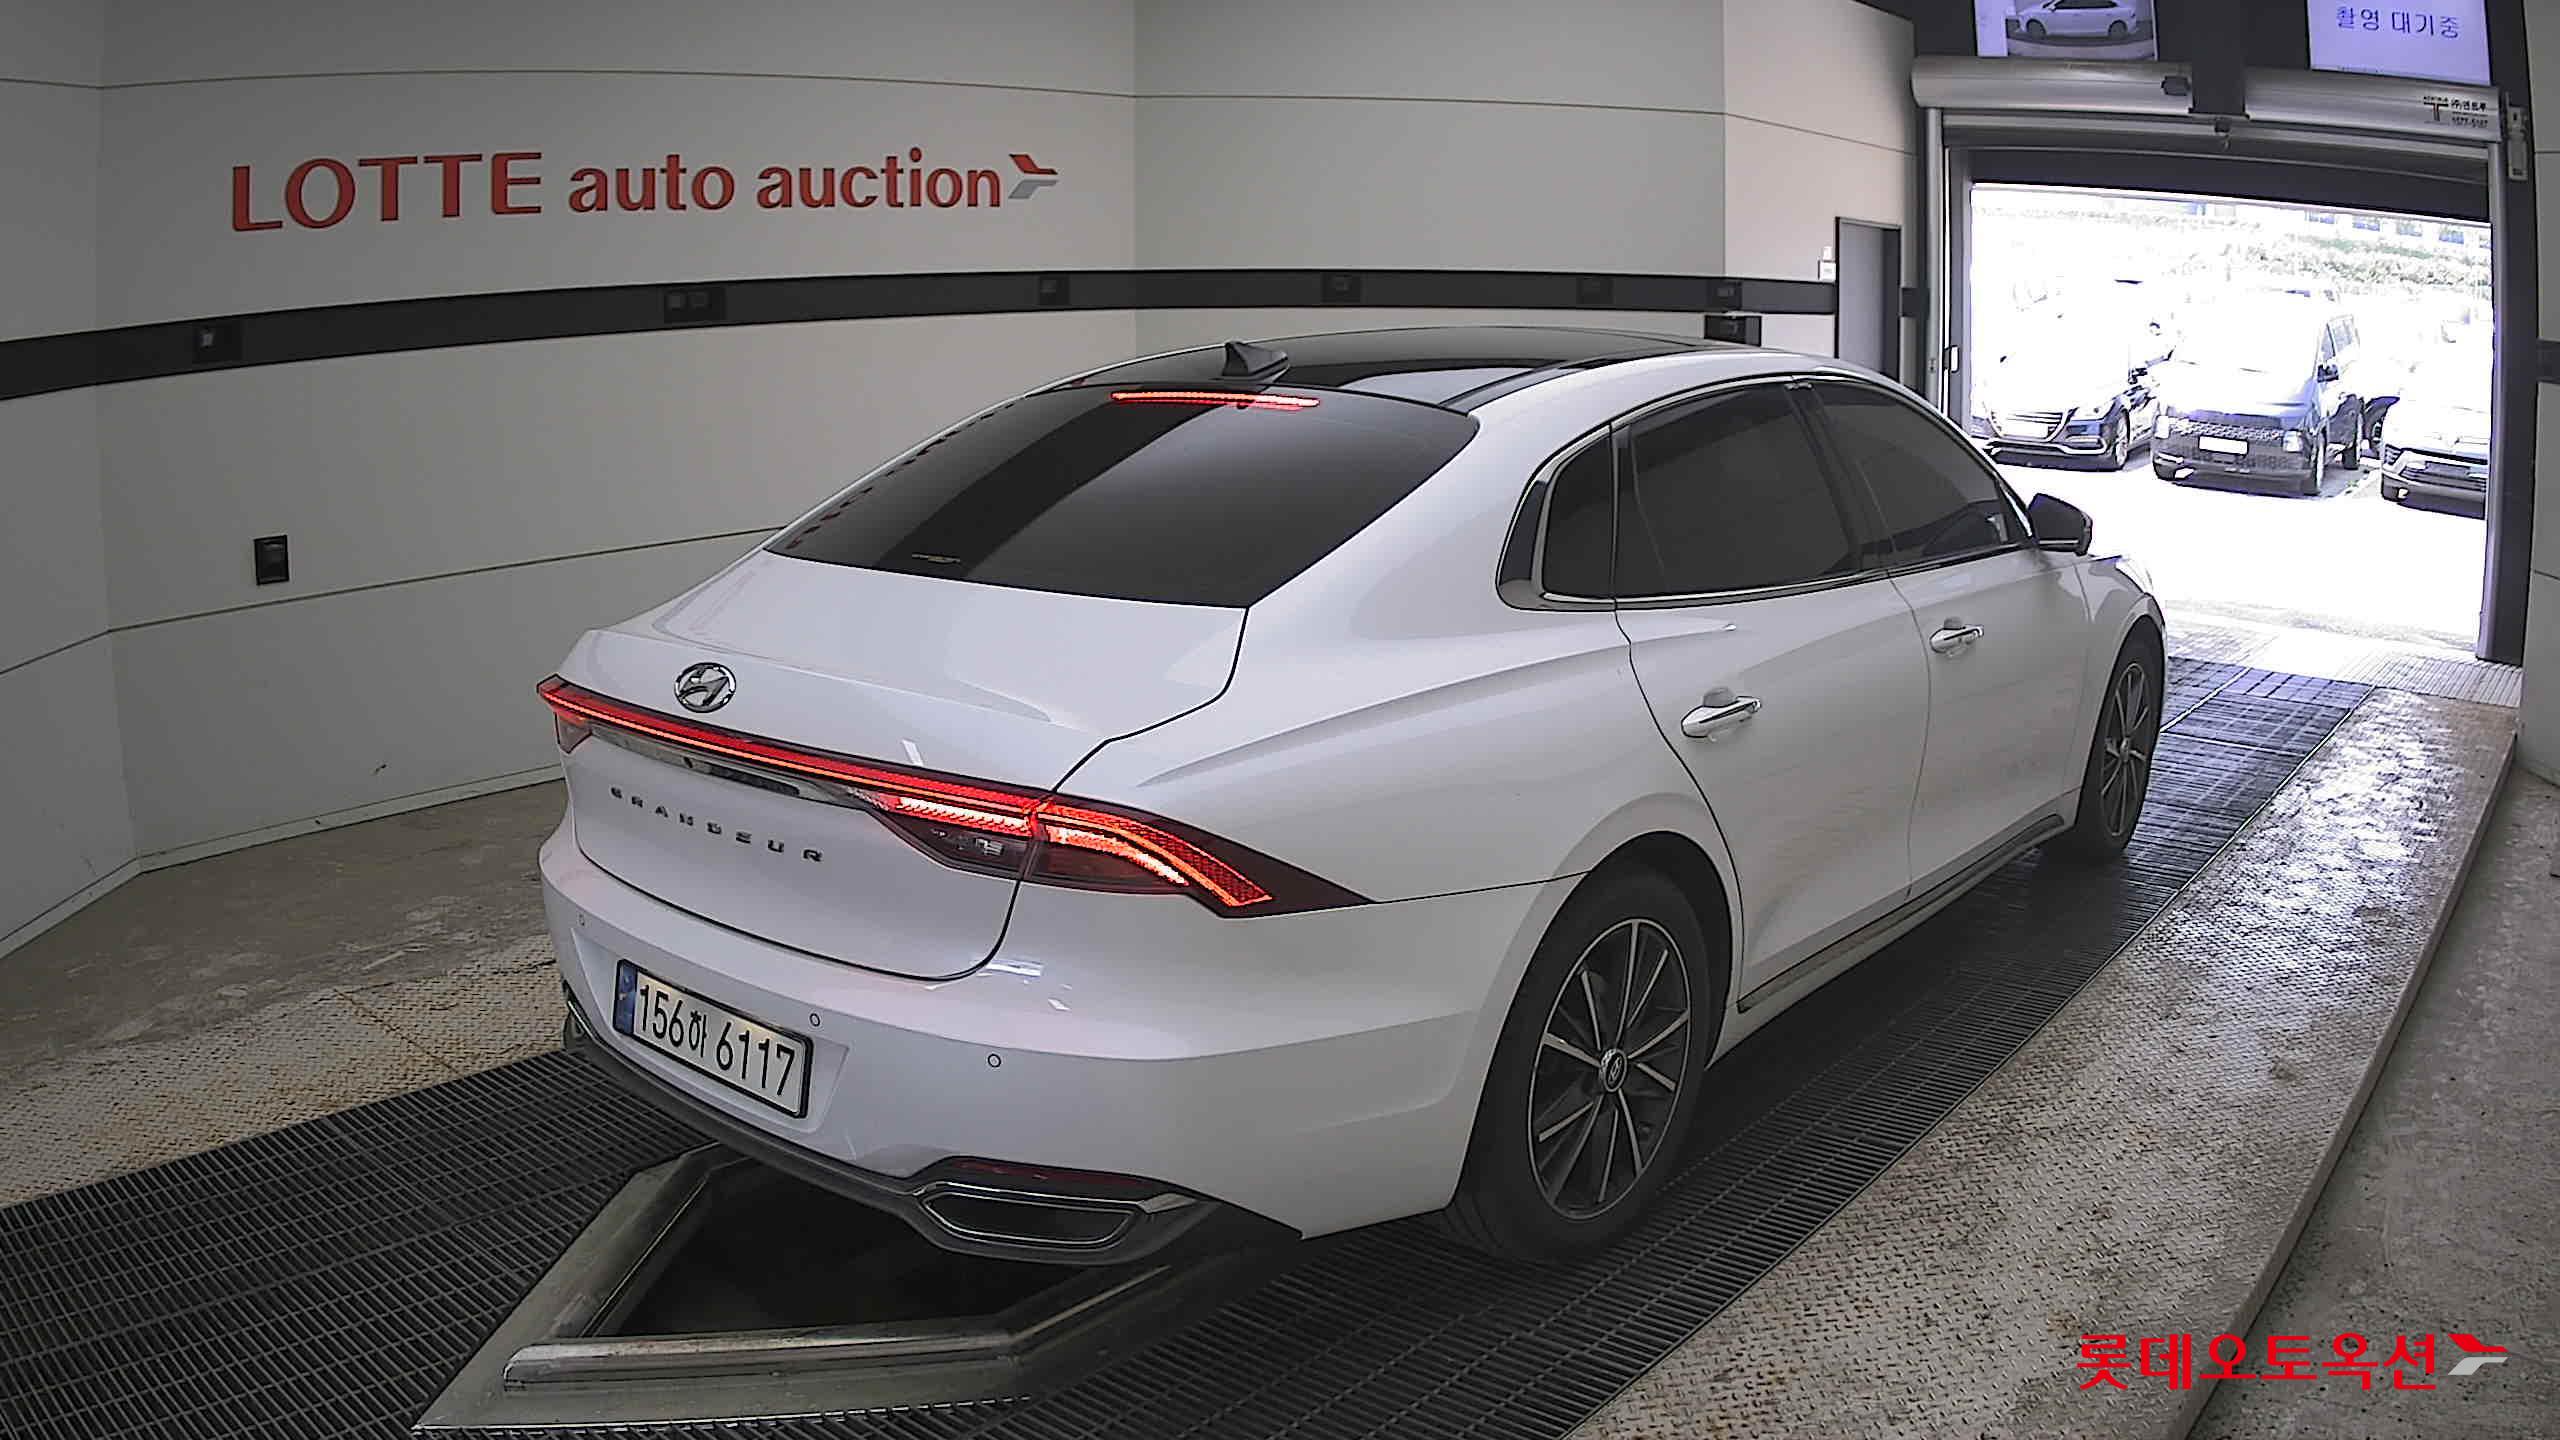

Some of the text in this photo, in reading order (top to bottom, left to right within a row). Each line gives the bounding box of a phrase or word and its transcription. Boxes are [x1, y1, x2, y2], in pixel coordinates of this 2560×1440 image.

[2391, 11, 2460, 39] 대기중
[233, 149, 1003, 231] LOTTE auto auction
[610, 785, 824, 863] GRANDEUR
[639, 984, 796, 1096] 156하 6117
